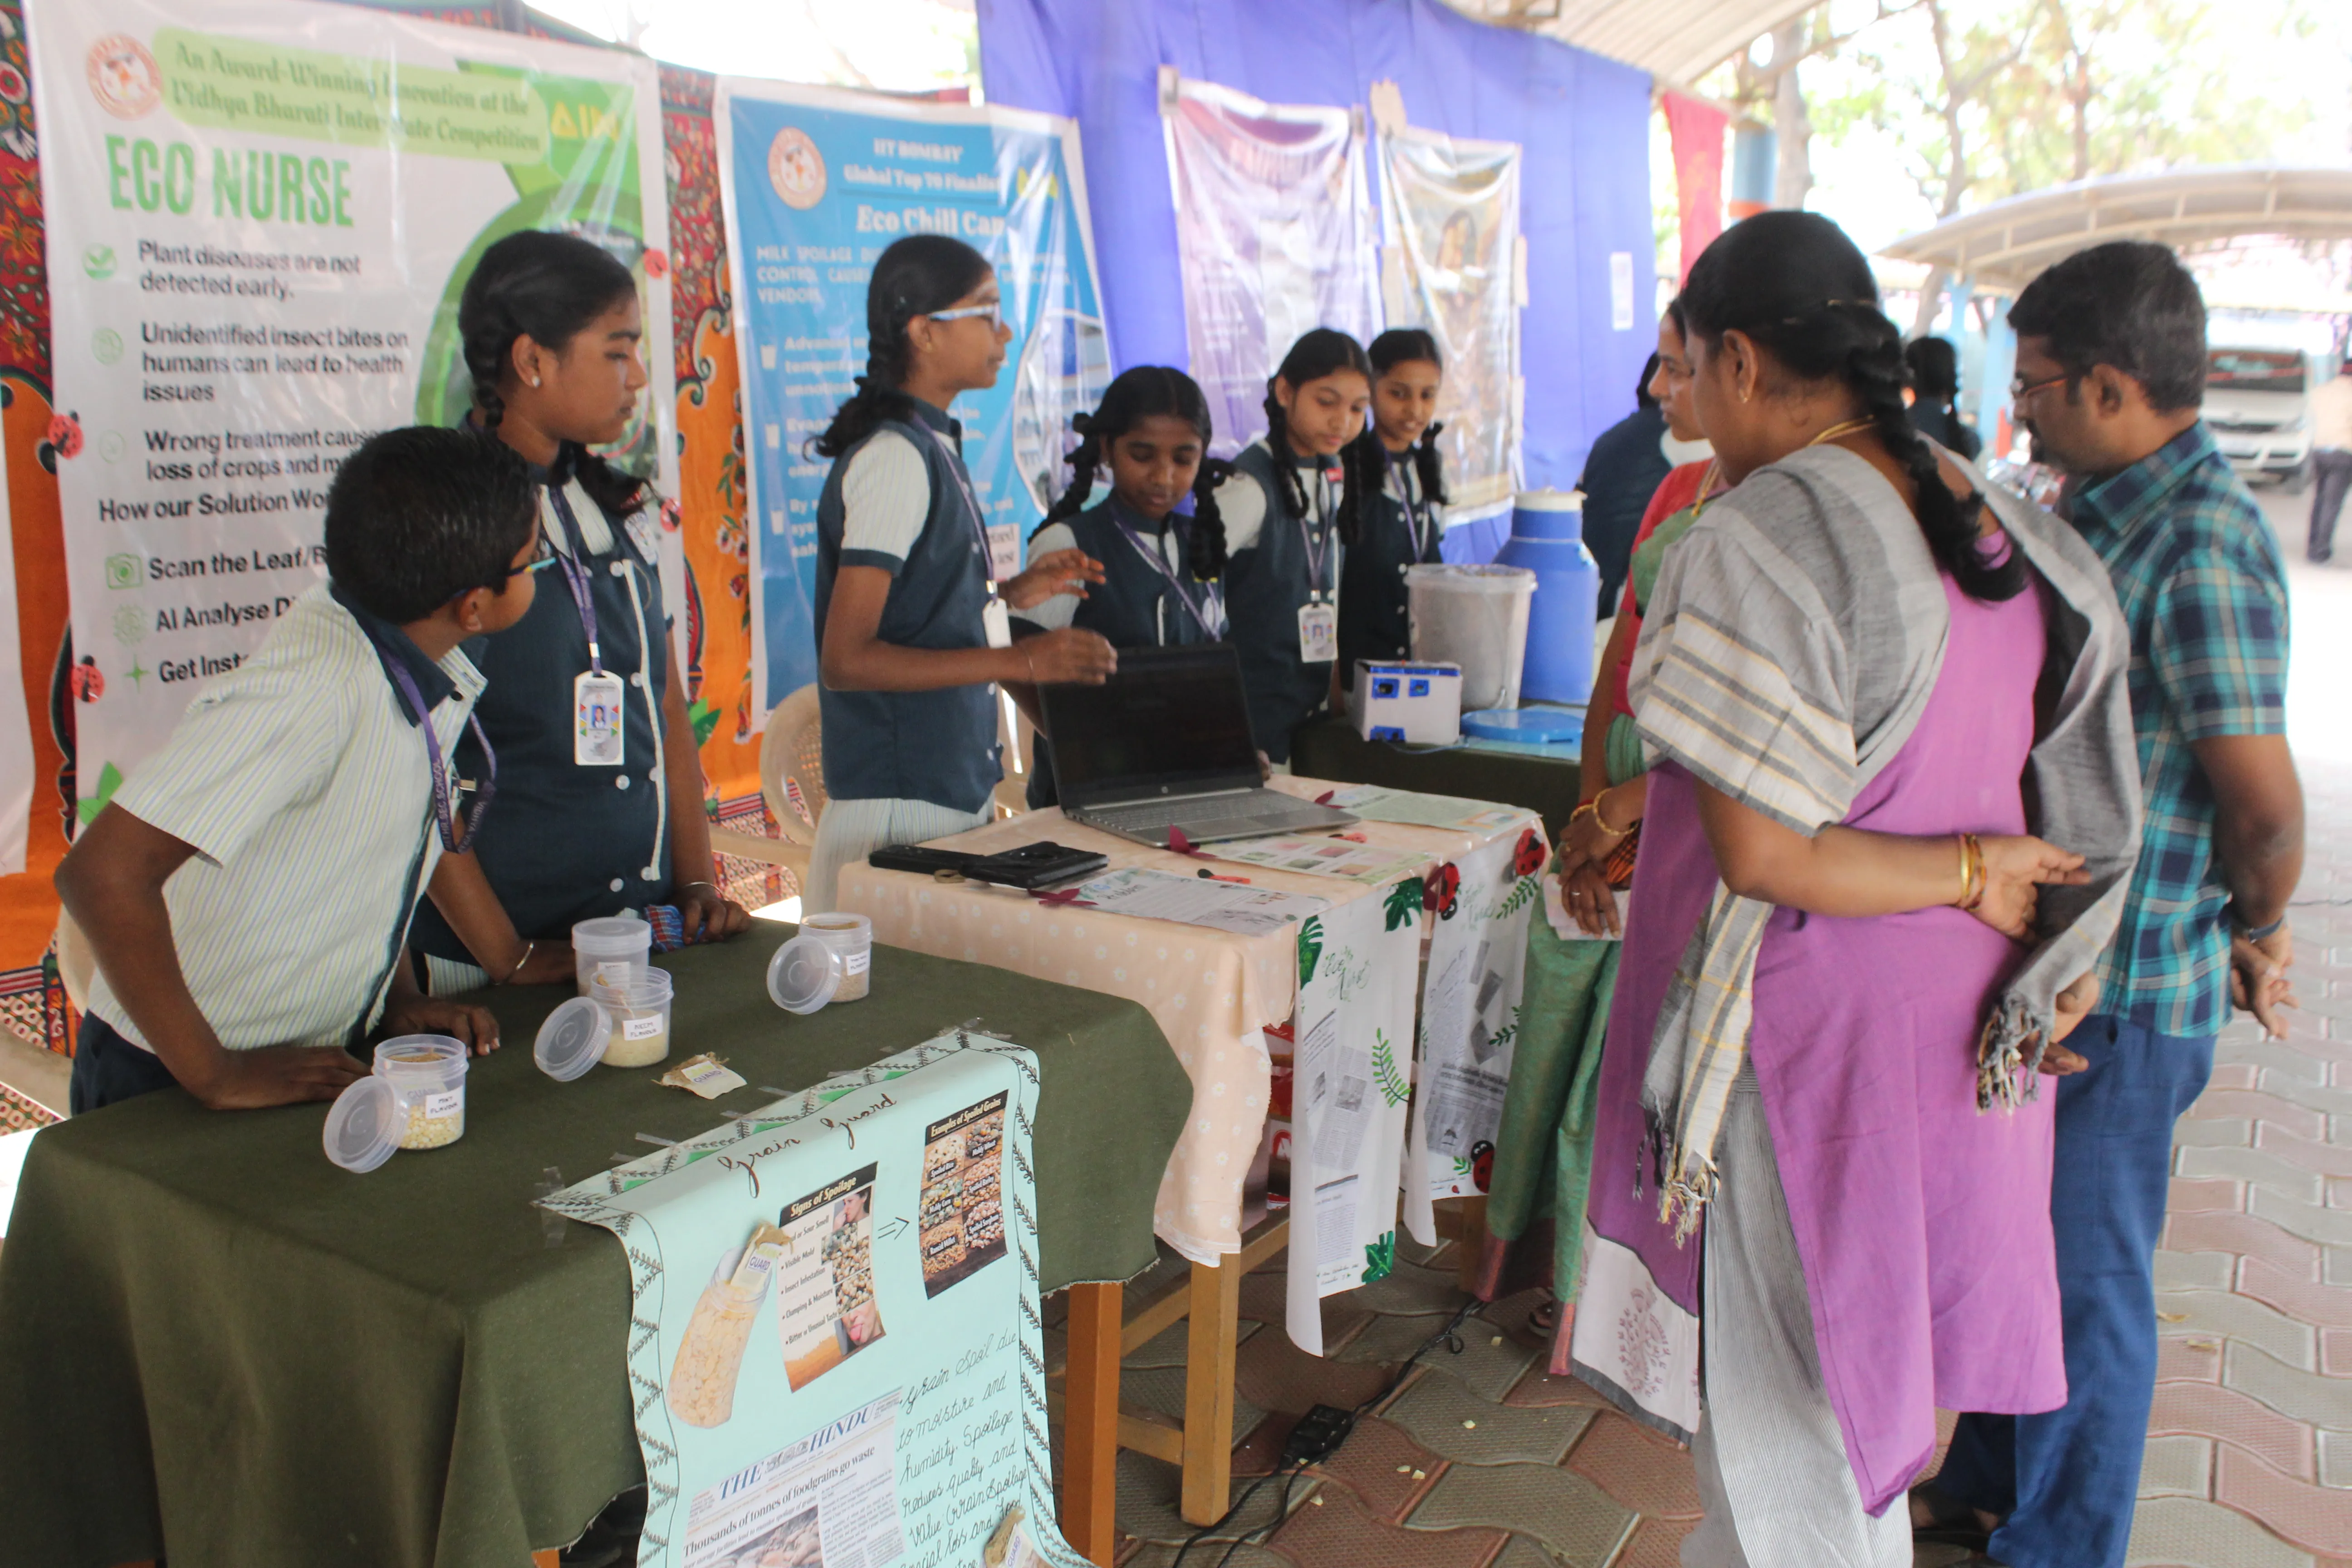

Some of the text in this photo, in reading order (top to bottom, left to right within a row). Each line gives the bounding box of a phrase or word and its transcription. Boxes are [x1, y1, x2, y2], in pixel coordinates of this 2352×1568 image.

[176, 40, 205, 70] An
[480, 91, 500, 111] at
[503, 94, 528, 115] the
[254, 91, 329, 123] Bharati
[437, 120, 540, 152] Competition
[104, 134, 354, 228] ECO NURSE
[843, 163, 891, 186] Global
[893, 169, 922, 192] Top
[857, 205, 900, 233] Eco
[903, 206, 958, 235] Chill
[139, 239, 361, 274] Plant diseases are not
[756, 245, 789, 262] MILK
[140, 271, 295, 300] detected early.
[142, 323, 409, 348] Unidentified insect bites on
[142, 351, 404, 375] humans can lead to health
[143, 381, 215, 401] issues
[145, 430, 221, 457] Wrong
[225, 429, 322, 450] treatment
[146, 458, 192, 481] loss
[198, 456, 220, 478] of
[222, 458, 280, 483] crops
[285, 454, 319, 475] and
[98, 498, 148, 522] How
[154, 499, 191, 518] our
[198, 490, 289, 517] Solution
[149, 556, 206, 580] Scan
[211, 550, 248, 574] the
[157, 608, 178, 632] AI
[183, 602, 270, 628] Analyse
[160, 652, 250, 683] Get Inst
[634, 1022, 654, 1030] NEEM
[694, 1069, 722, 1083] GUARD
[931, 1098, 1001, 1137] Examples of Spoiled Grains
[790, 1177, 857, 1218] Signs of Spoilage
[803, 1225, 815, 1236] Sour
[815, 1215, 829, 1229] Smell
[750, 1256, 770, 1271] GUARD
[785, 1246, 815, 1269] Visible Mold
[784, 1267, 826, 1294] Insect Infestation
[786, 1303, 808, 1319] Clumping
[813, 1288, 833, 1303] Moisture
[789, 1330, 803, 1344] Bitter
[808, 1317, 826, 1333] Unusual
[826, 1311, 838, 1322] Taste
[996, 1327, 1016, 1352] due
[897, 1428, 914, 1452] to
[916, 1397, 974, 1438] moisture
[982, 1370, 1007, 1401] and
[963, 1410, 1013, 1449] Spoilage
[719, 1460, 764, 1501] THE
[809, 1403, 876, 1452] HINDU
[946, 1457, 985, 1498] quality
[989, 1437, 1017, 1468] and
[986, 1465, 1027, 1502] Spoilage
[683, 1520, 738, 1558] Thousands
[739, 1512, 750, 1529] of
[750, 1499, 782, 1522] tonnes
[782, 1490, 794, 1504] of
[793, 1467, 838, 1499] foodgrains
[839, 1460, 851, 1473] go
[851, 1446, 875, 1466] waste
[945, 1527, 968, 1558] loss
[970, 1514, 994, 1541] and
[1007, 1536, 1020, 1567] GUARD
